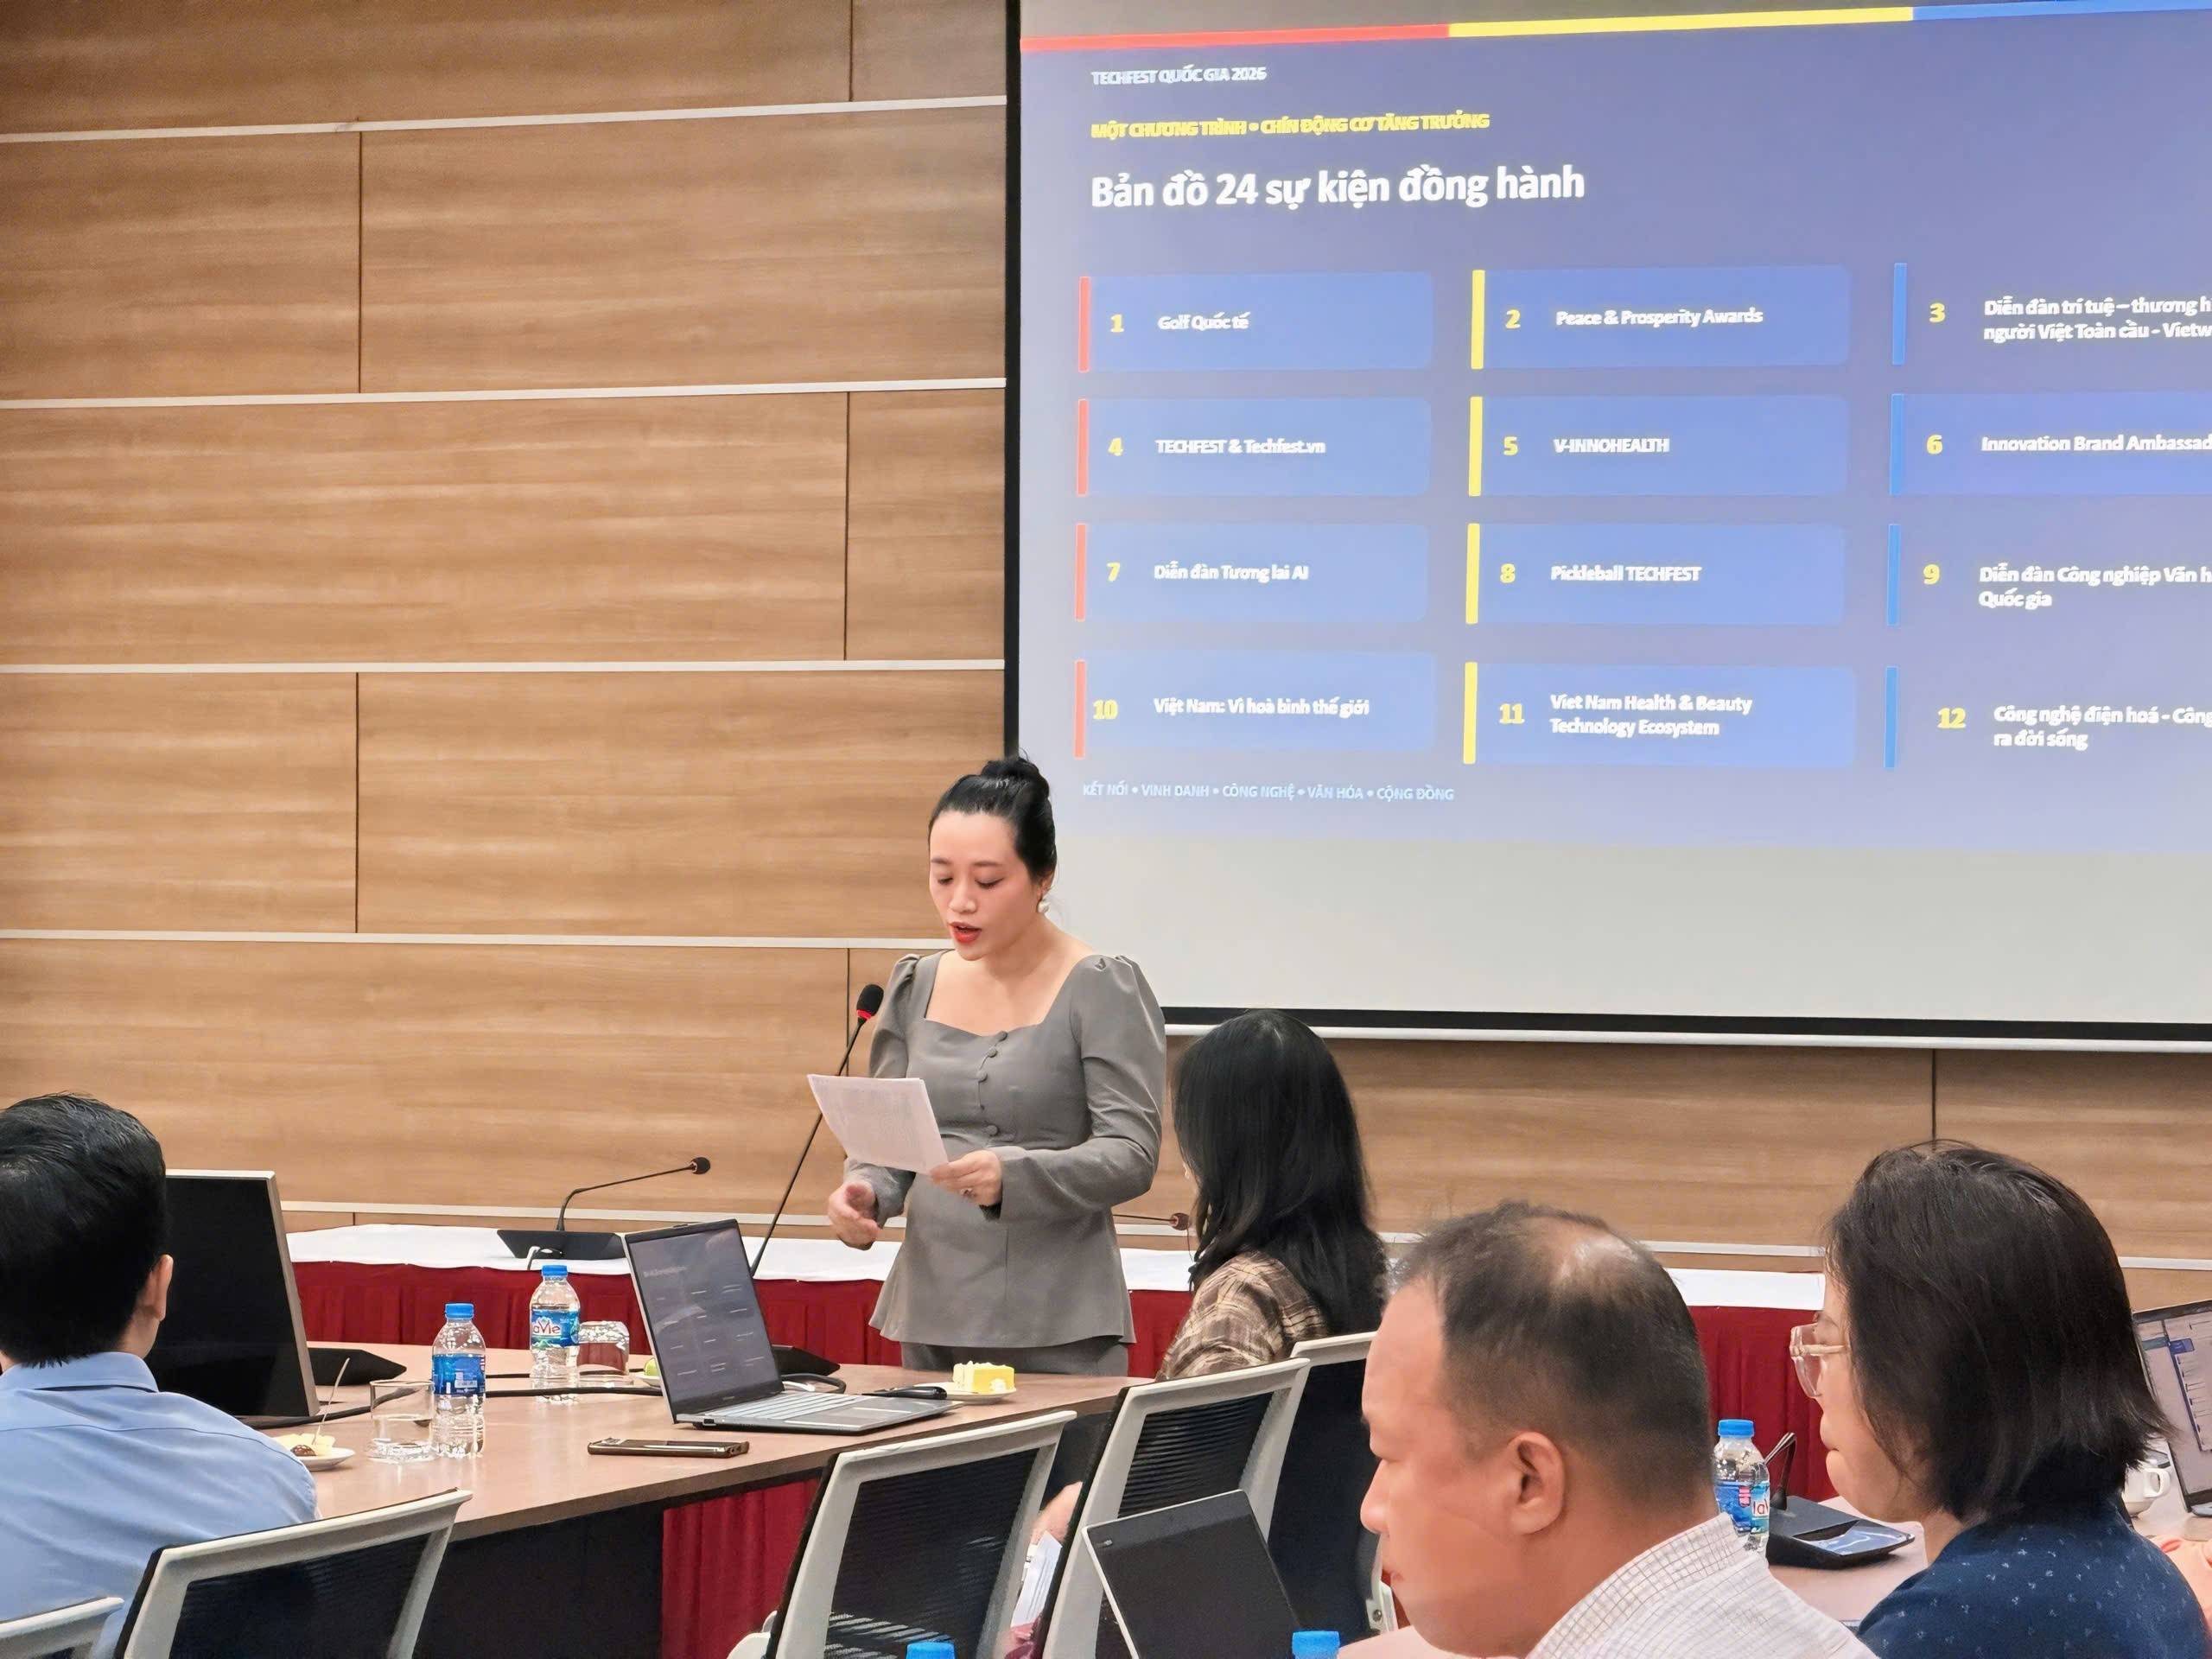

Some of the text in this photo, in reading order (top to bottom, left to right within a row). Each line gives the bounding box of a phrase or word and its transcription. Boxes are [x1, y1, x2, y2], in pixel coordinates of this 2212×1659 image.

[1091, 70, 1158, 85] TECHFEST
[1159, 64, 1203, 84] QUỐC
[1204, 68, 1230, 81] GIA
[1091, 163, 1585, 210] Bản đồ 24 sự kiện đồng hành
[1929, 302, 1946, 323] 3
[1985, 296, 2024, 315] Diễn
[2025, 298, 2060, 315] đàn
[2062, 298, 2083, 314] trí
[2084, 297, 2115, 317] tuệ
[2131, 296, 2199, 316] thương
[1109, 315, 1124, 333] 1
[1158, 311, 1251, 332] Golf Quốc tế
[1505, 310, 1521, 328] 2
[1555, 307, 1764, 327] Peace & Prosperity Awards
[1984, 322, 2036, 344] người
[2037, 322, 2074, 342] Việt
[2075, 321, 2116, 339] Toàn
[2119, 319, 2150, 339] cầu
[1109, 438, 1123, 456] 4
[1154, 439, 1326, 454] TECHFEST & Techfest.vn
[1503, 437, 1519, 455] 5
[1554, 438, 1670, 453] V-INNOHEALTH
[1926, 435, 1943, 454] 6
[1981, 436, 2071, 451] Innovation
[2074, 435, 2124, 450] Brand
[1107, 563, 1121, 582] 7
[1154, 561, 1310, 583] Diễn đàn Tương lai AI
[1500, 564, 1516, 583] 8
[1551, 566, 1702, 582] Pickleball TECHFEST
[1923, 564, 1941, 585] 9
[1980, 563, 2019, 582] Diễn
[2021, 566, 2055, 582] đàn
[2056, 566, 2101, 587] Công
[2102, 565, 2161, 586] nghiệp
[2163, 566, 2197, 582] Văn
[1979, 588, 2053, 610] Quốc gia
[1093, 700, 1118, 720] 10
[1154, 697, 1184, 715] Việt
[1186, 699, 1226, 714] Nam:
[1313, 696, 1340, 714] thế
[1338, 698, 1370, 719] giới
[1499, 704, 1524, 724] 11
[1550, 695, 1753, 715] Viet Nam Health & Beauty
[1937, 708, 1967, 728] 12
[1993, 705, 2037, 725] Công
[2039, 705, 2082, 726] nghệ
[2083, 706, 2123, 726] điện
[2126, 706, 2159, 723] hoá
[1550, 719, 1719, 738] Technology Ecosystem
[1993, 728, 2088, 751] ra đời sống
[1083, 779, 1104, 796] KẾT
[1141, 785, 1171, 797] VINH
[1174, 785, 1210, 798] DANH
[1223, 783, 1257, 798] CÔNG
[1261, 783, 1295, 801] NGHỆ
[1307, 785, 1333, 799] VĂN
[1337, 785, 1363, 800] HÓA
[1376, 785, 1413, 803] CỘNG
[1416, 784, 1455, 800] ĐỒNG
